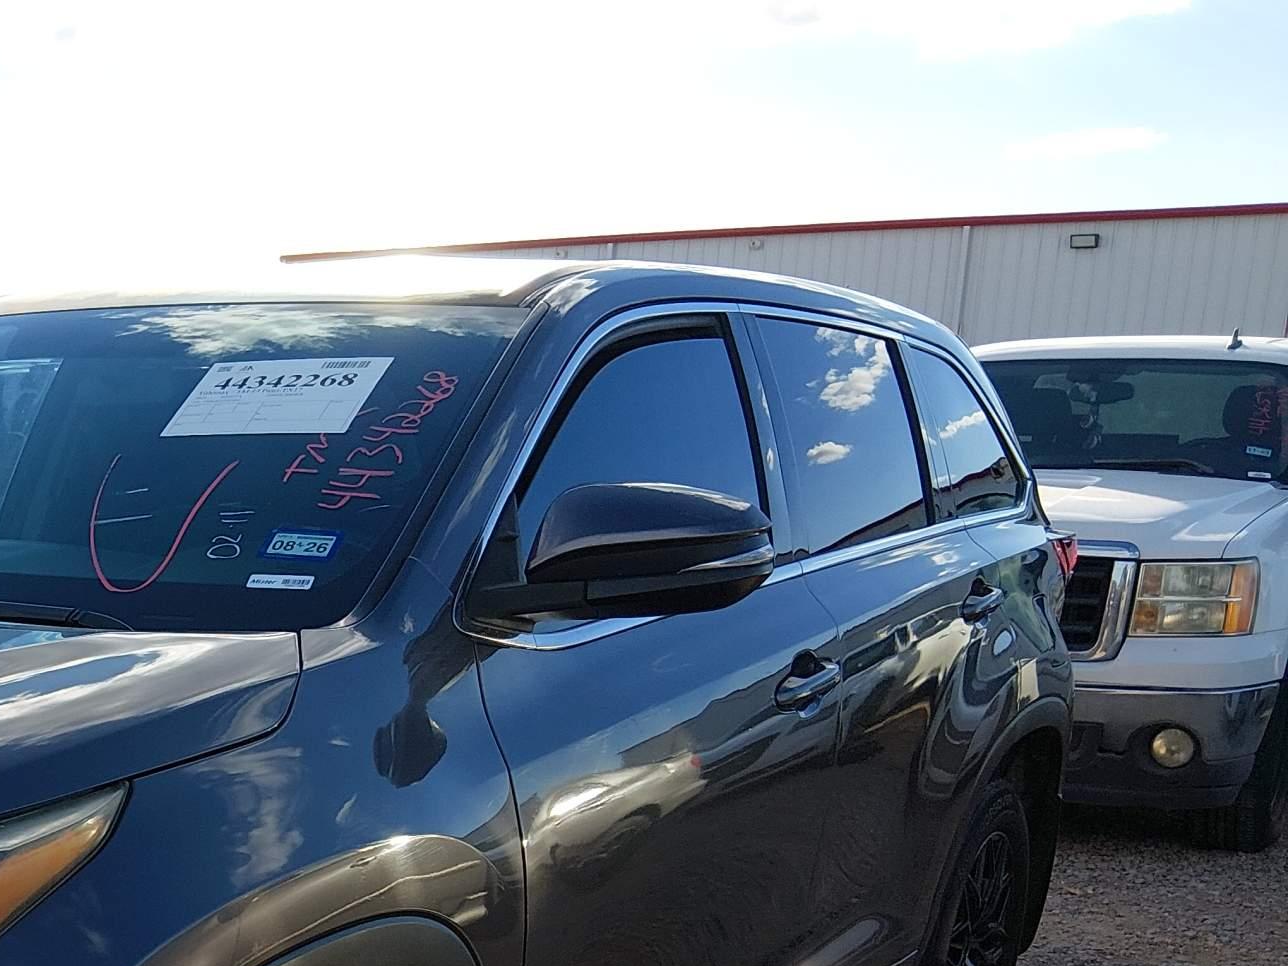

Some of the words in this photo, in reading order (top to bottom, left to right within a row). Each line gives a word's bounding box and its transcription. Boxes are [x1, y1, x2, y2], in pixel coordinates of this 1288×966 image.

[214, 373, 358, 390] 44342268
[317, 370, 460, 509] 44342268
[272, 540, 296, 552] 08
[303, 542, 329, 554] 26
